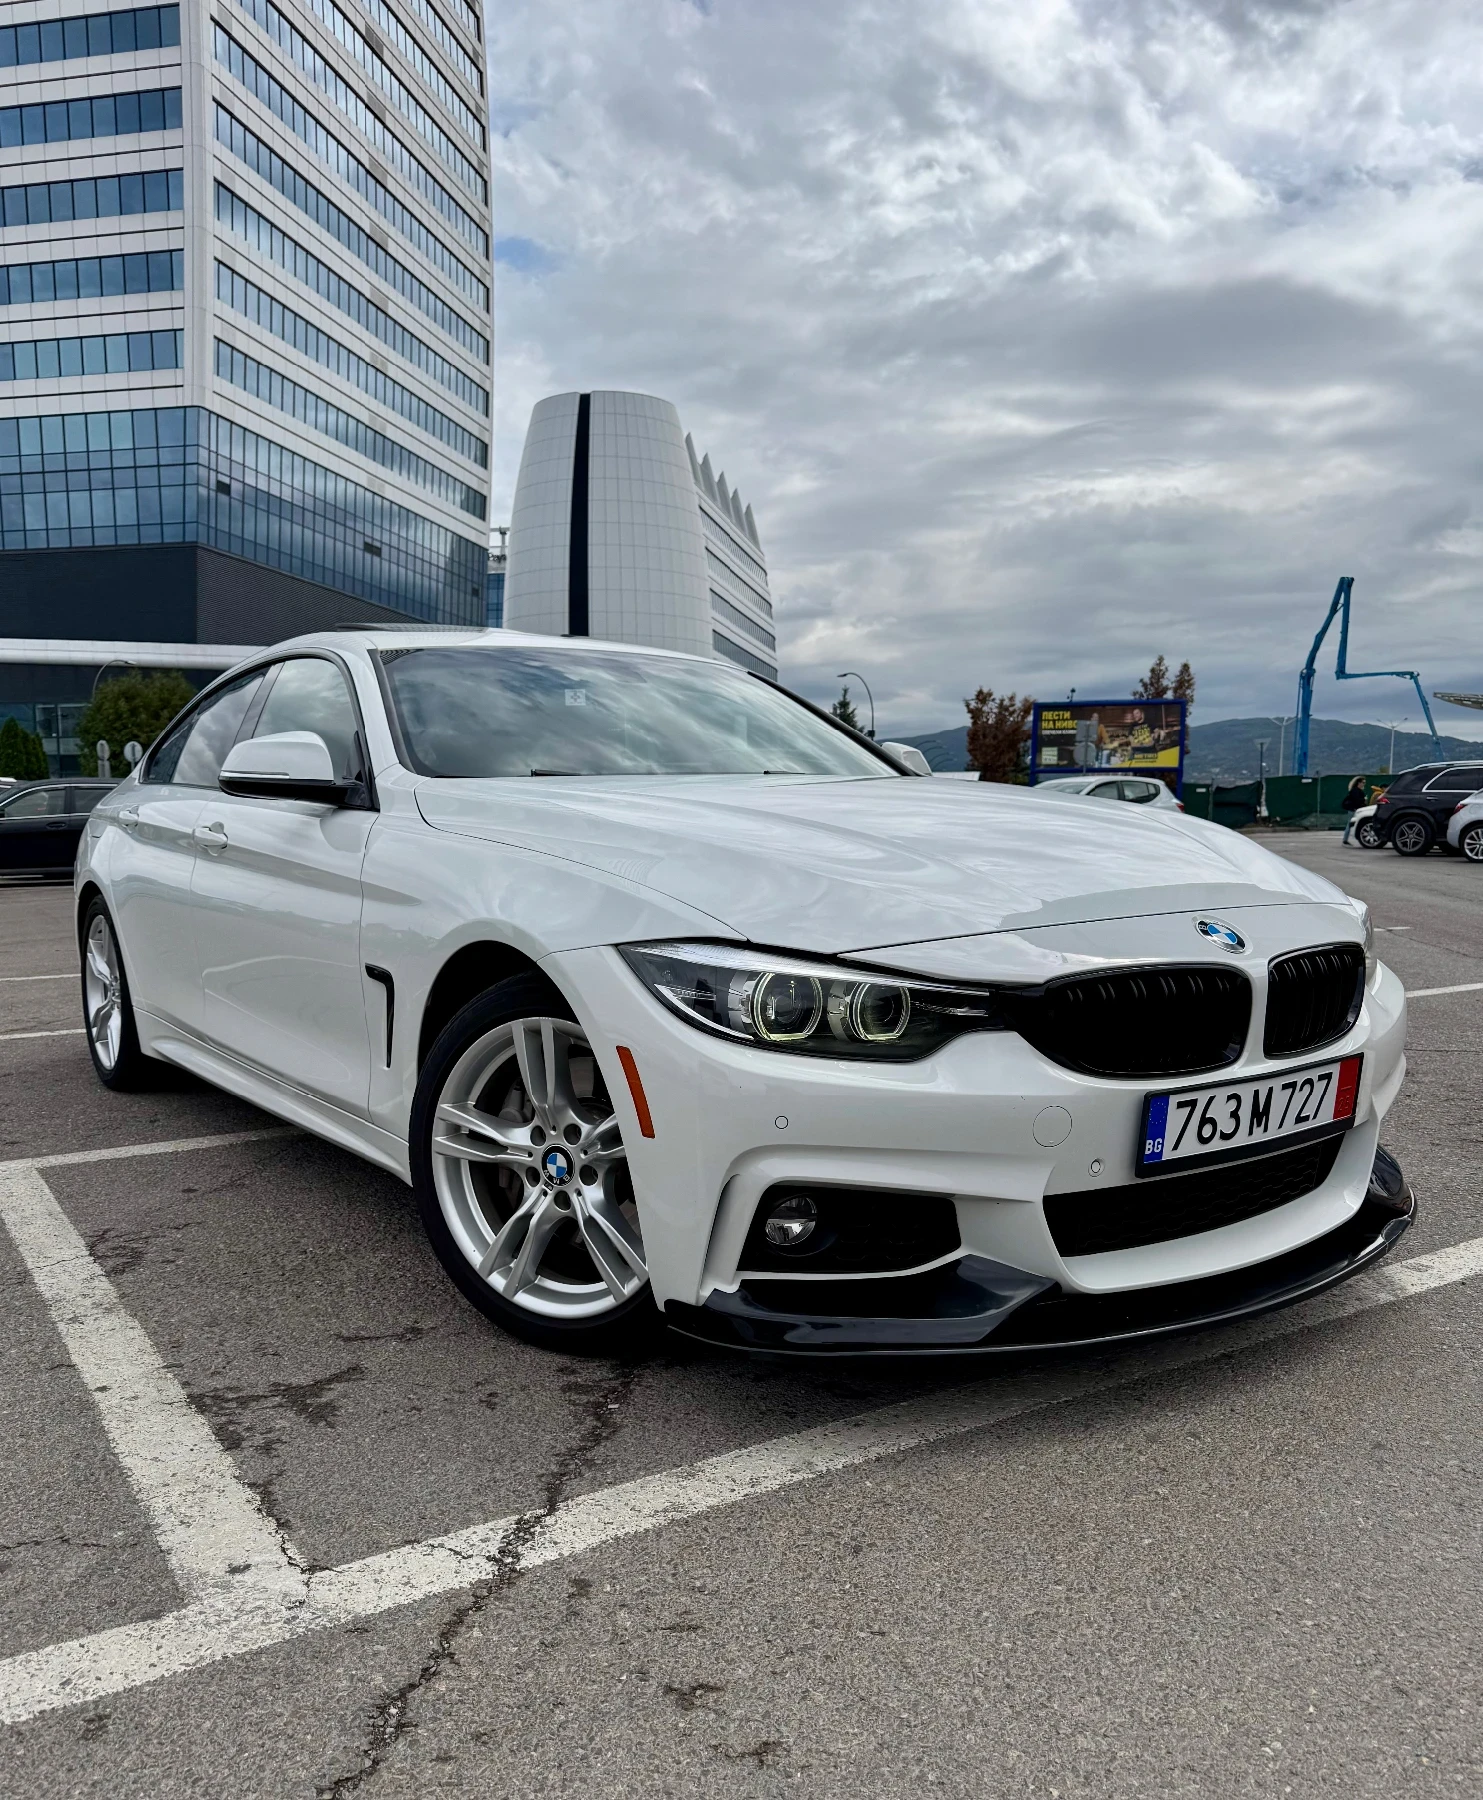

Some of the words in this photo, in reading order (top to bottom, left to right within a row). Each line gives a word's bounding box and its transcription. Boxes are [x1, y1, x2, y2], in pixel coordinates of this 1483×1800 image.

[1042, 711, 1071, 720] ПЕСТИ
[1042, 720, 1054, 729] НА
[1171, 1092, 1242, 1151] 763
[1247, 1086, 1274, 1136] M
[1278, 1071, 1333, 1129] 727
[1144, 1138, 1162, 1155] BG
